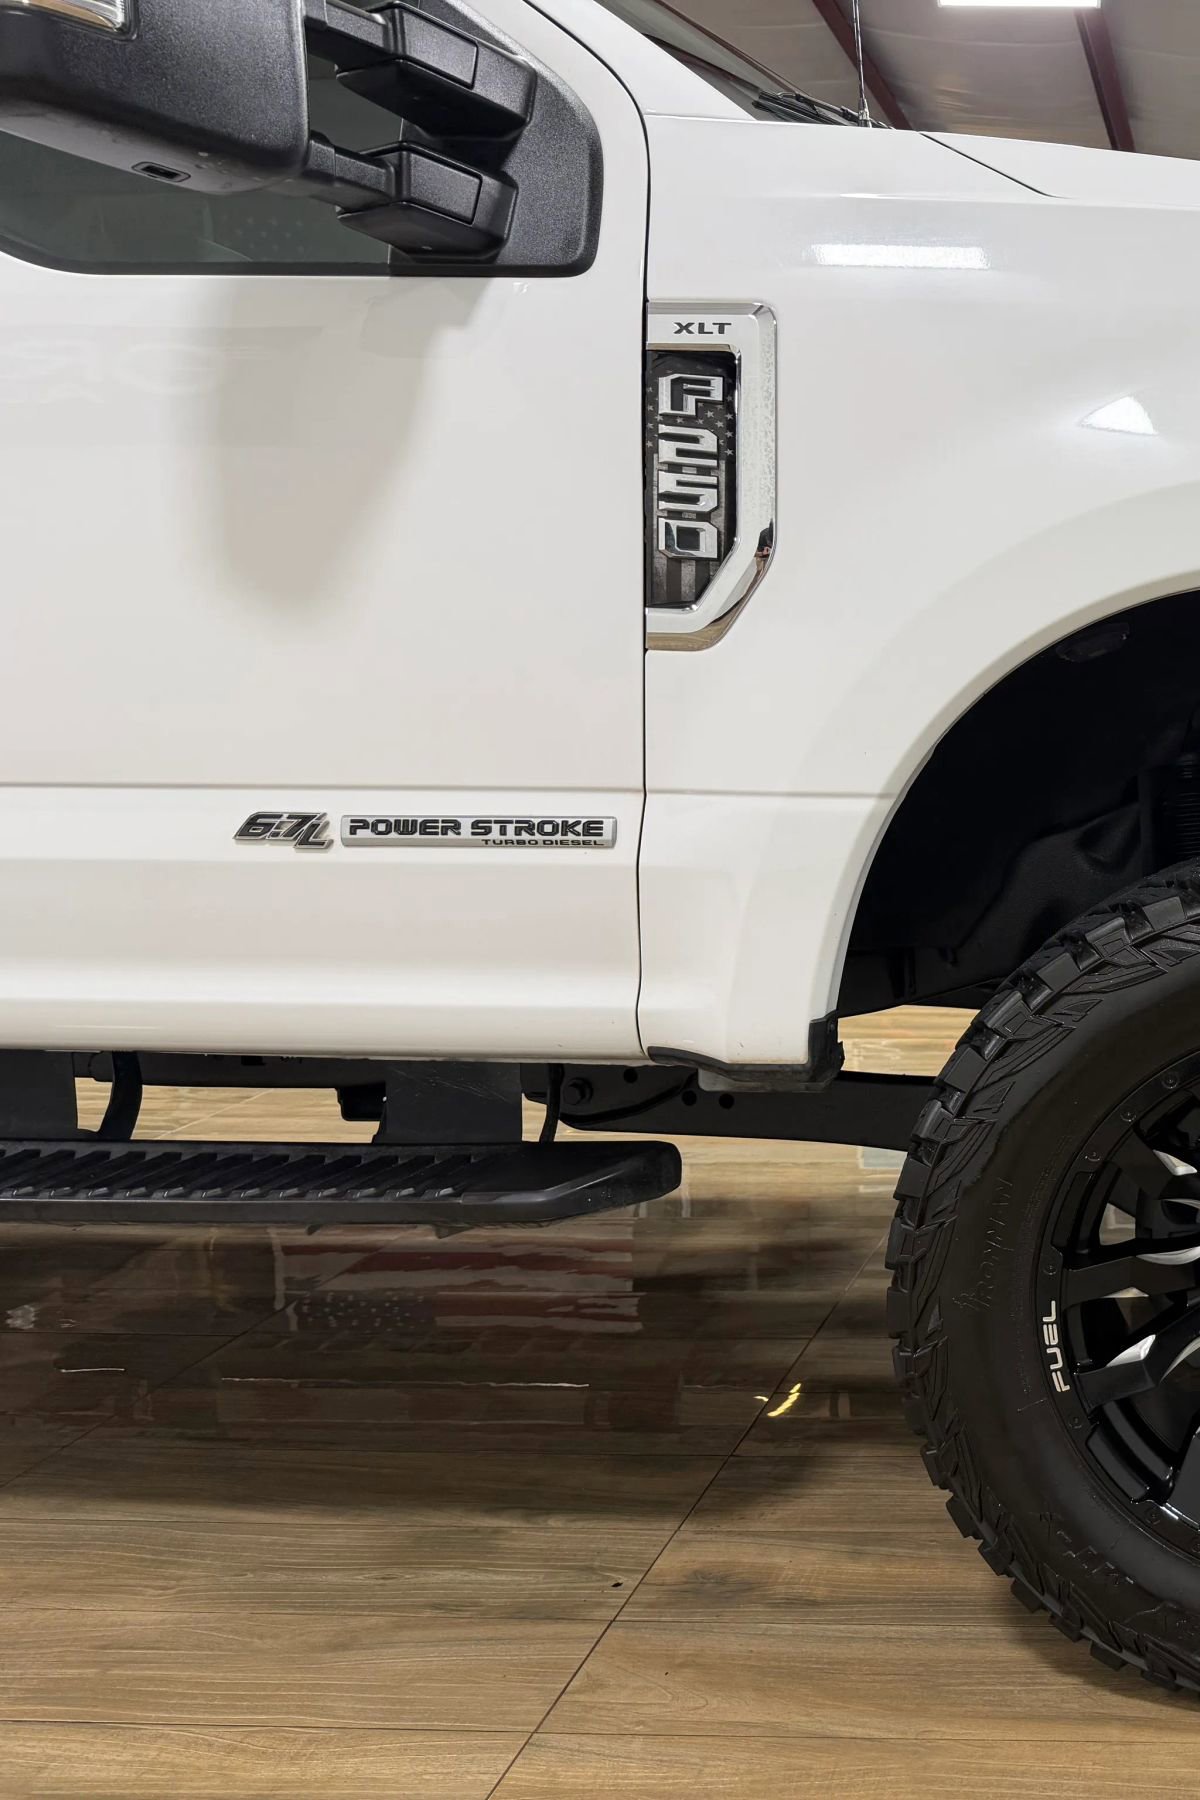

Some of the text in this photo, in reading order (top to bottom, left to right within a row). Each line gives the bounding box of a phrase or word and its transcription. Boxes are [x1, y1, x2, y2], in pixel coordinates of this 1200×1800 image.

[673, 322, 732, 335] XLT
[234, 812, 333, 849] 6.7L
[349, 819, 604, 837] POWER STROKE
[1042, 1300, 1071, 1392] FUEL
